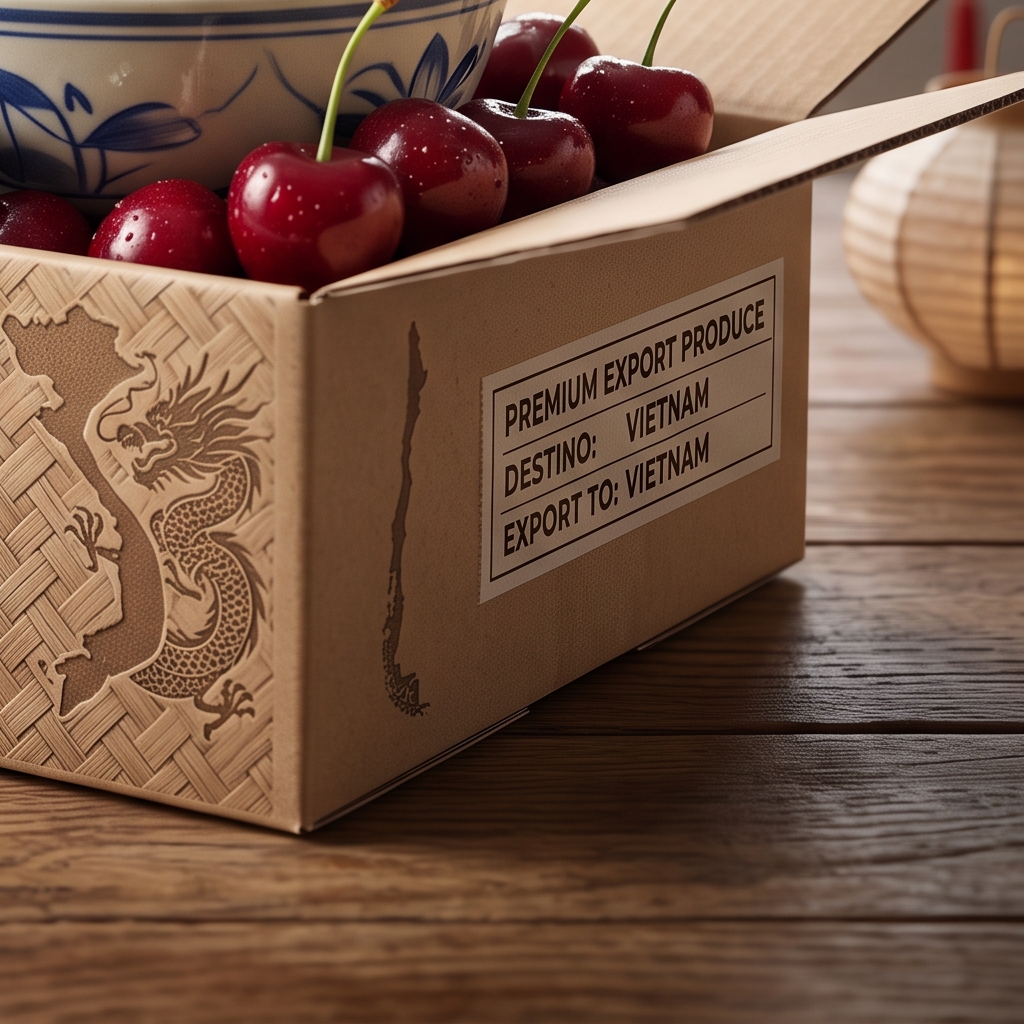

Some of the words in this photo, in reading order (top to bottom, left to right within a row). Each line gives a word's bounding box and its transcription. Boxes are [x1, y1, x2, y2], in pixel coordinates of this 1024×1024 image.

[505, 368, 597, 437] PREMIUM
[604, 335, 677, 395] EXPORT
[681, 299, 765, 362] PRODUCE
[504, 491, 582, 557] EXPORT
[588, 479, 619, 516] TO:
[625, 432, 709, 499] VIETNAM
[505, 432, 597, 498] DESTINO:
[626, 377, 709, 443] VIETNAM
